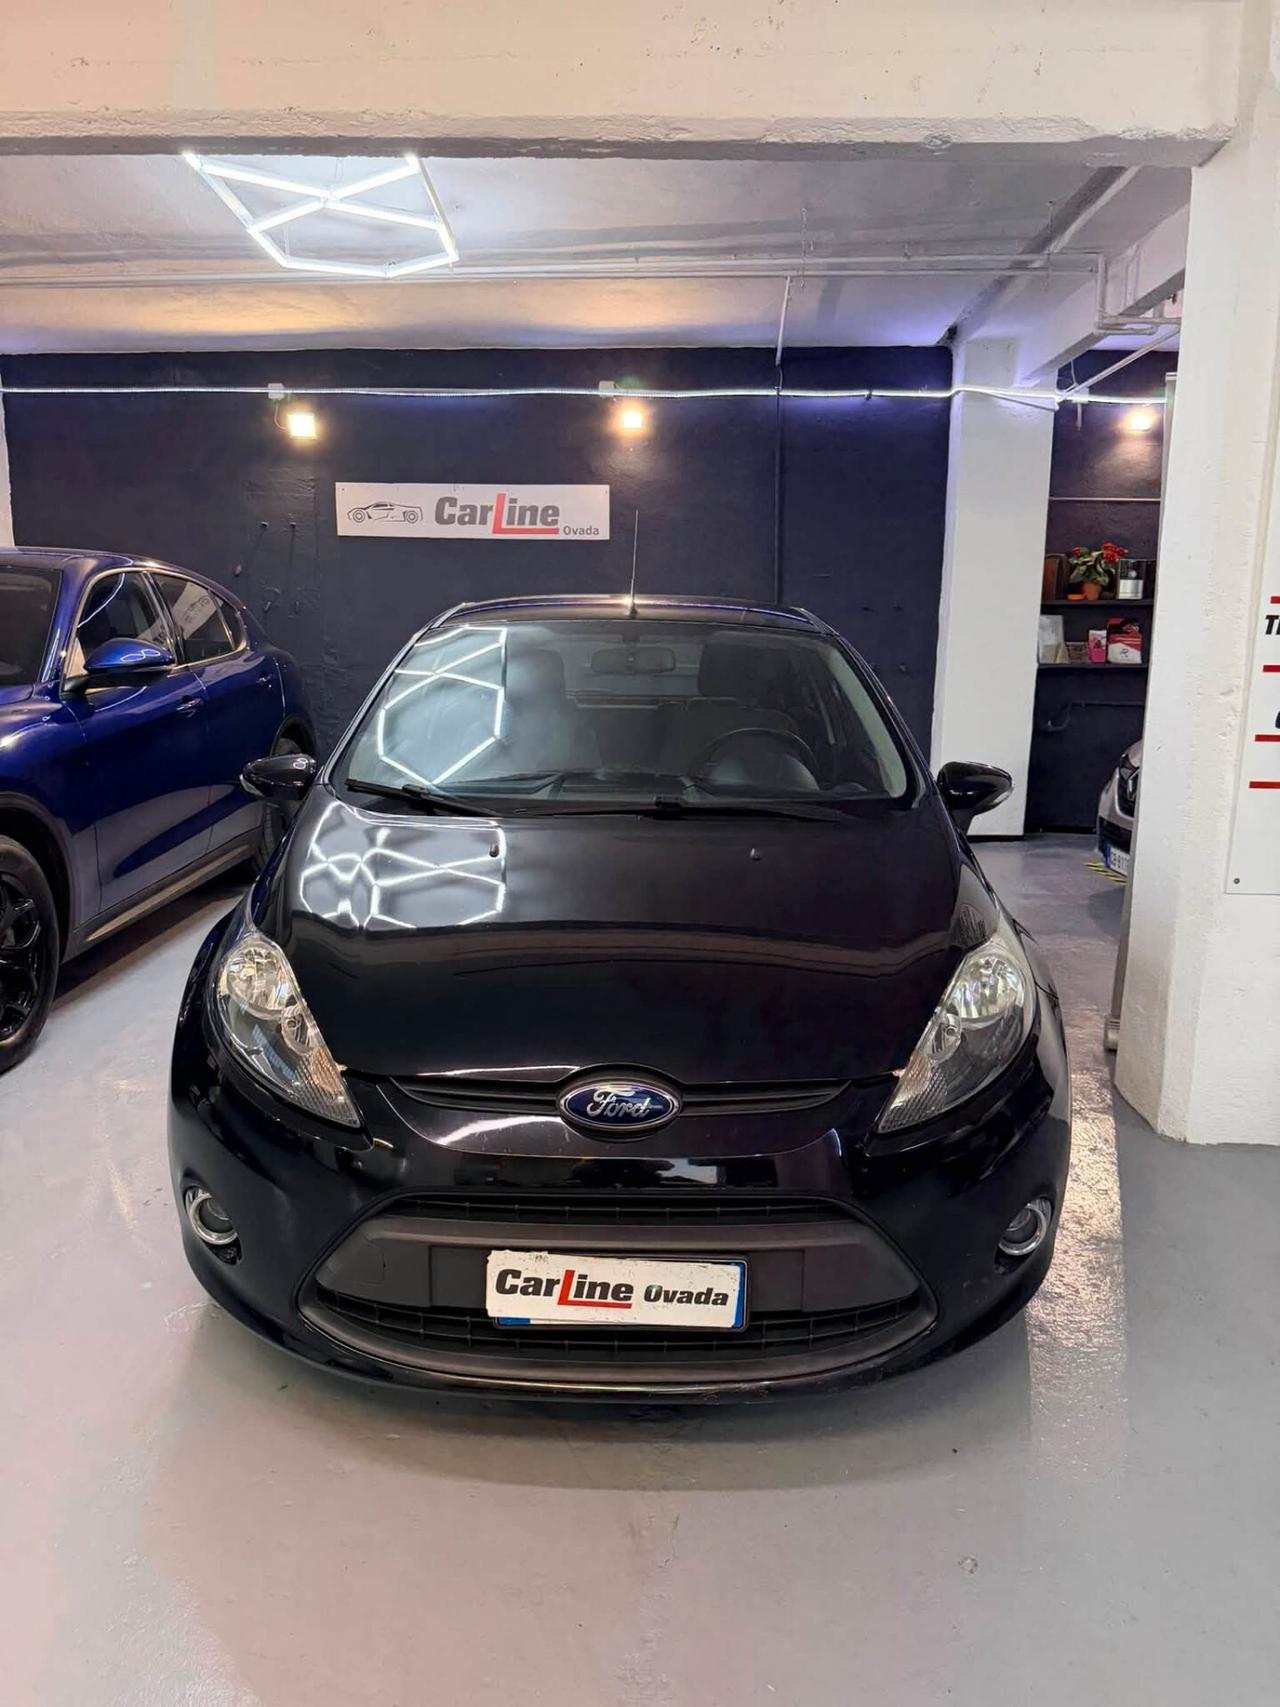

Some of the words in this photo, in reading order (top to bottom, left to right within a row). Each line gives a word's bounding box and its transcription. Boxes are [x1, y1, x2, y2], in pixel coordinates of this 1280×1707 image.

[435, 493, 560, 535] CarLine
[563, 526, 600, 536] Ovada
[586, 1086, 663, 1117] Ford
[495, 1269, 633, 1309] CarLine
[643, 1284, 729, 1306] Ovada
